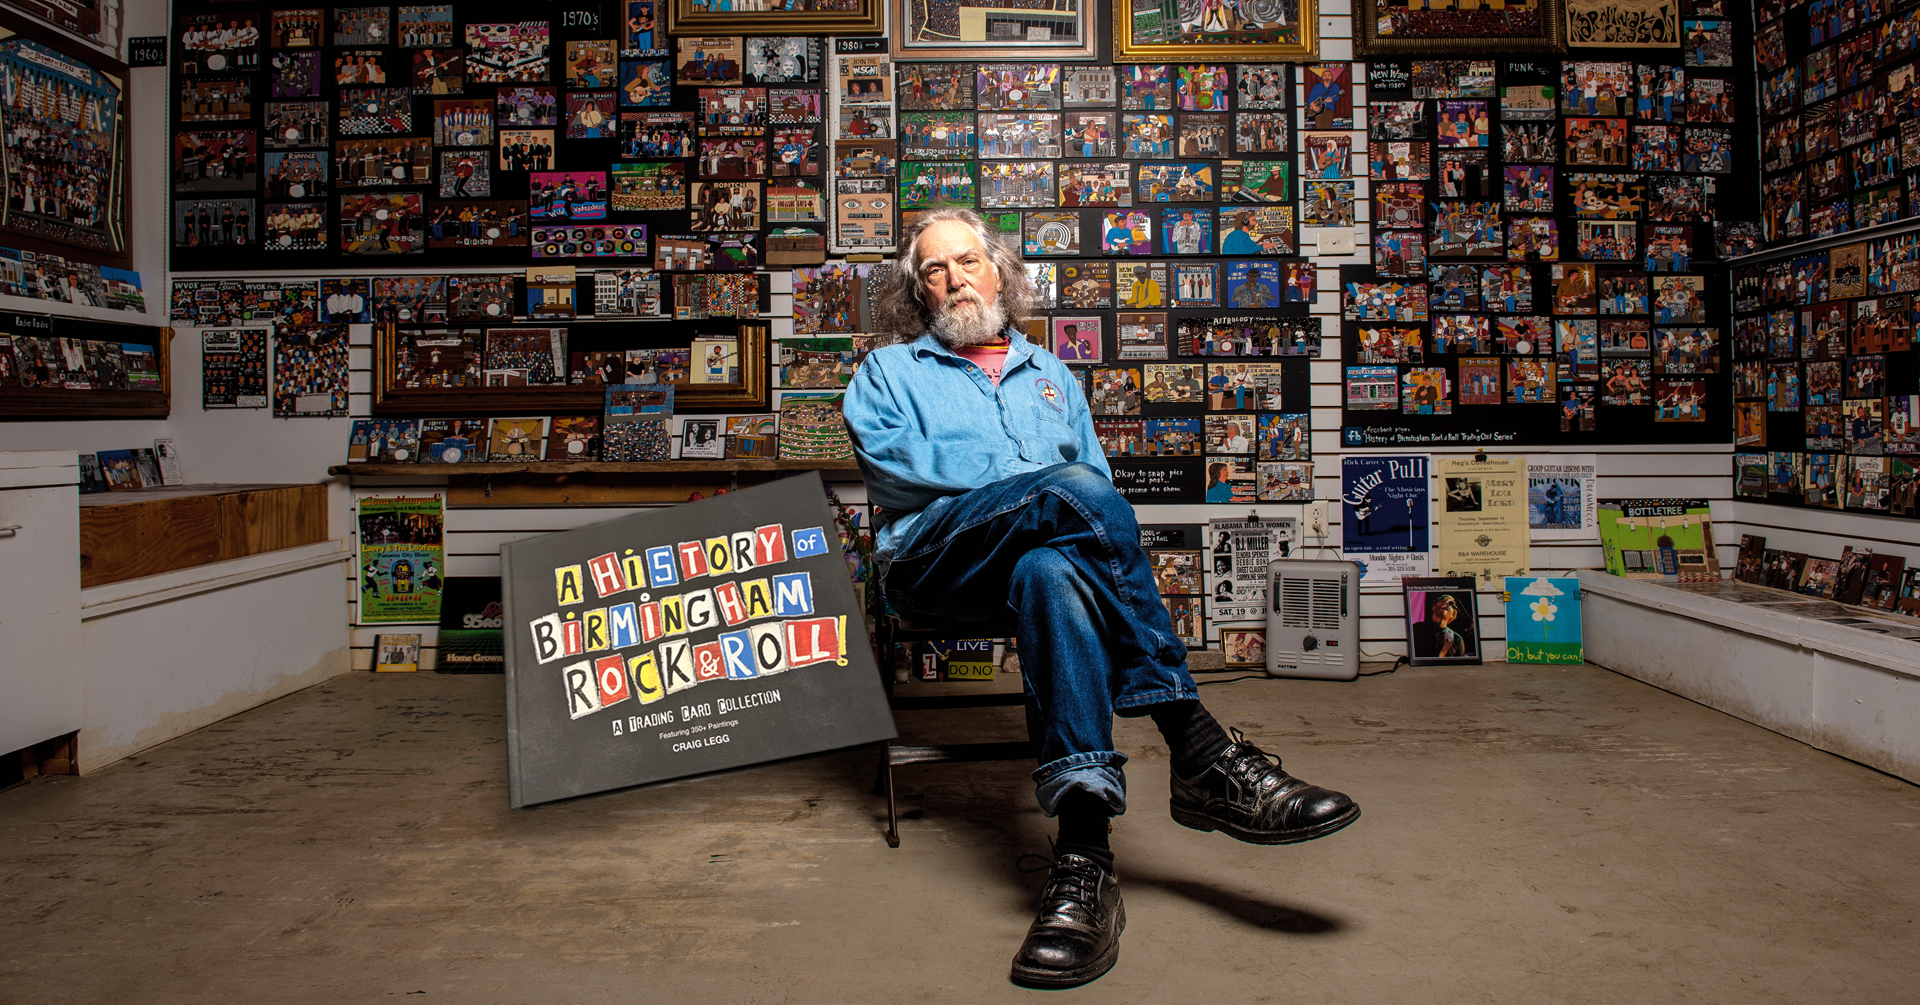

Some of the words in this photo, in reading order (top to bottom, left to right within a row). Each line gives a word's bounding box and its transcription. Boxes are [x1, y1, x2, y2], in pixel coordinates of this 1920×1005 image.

[563, 11, 598, 26] 1970's
[838, 40, 863, 50] 1980's
[1509, 62, 1534, 72] PUNK
[1370, 70, 1388, 82] New
[1000, 214, 1019, 230] 99
[16, 316, 31, 328] Radio
[32, 318, 49, 328] Radio
[1214, 316, 1253, 325] ASTROLOGY
[1348, 430, 1361, 442] fb
[1114, 469, 1135, 480] Okay
[1148, 470, 1165, 480] snap
[1169, 469, 1183, 478] pics
[1342, 470, 1383, 506] Guitar
[1388, 458, 1424, 480] Pull
[1628, 506, 1683, 516] BOTTLETREE
[362, 544, 385, 553] Larry
[409, 543, 440, 551] Loafers
[1247, 537, 1268, 550] MILLER
[1369, 554, 1386, 563] Monday
[556, 566, 582, 605] A
[589, 525, 786, 597] HISTORY
[794, 530, 822, 555] of
[462, 613, 502, 629] 95RO
[529, 572, 814, 664] BIRMINGHAM
[956, 642, 989, 651] LIVE
[446, 654, 471, 662] Home
[473, 654, 502, 662] Grown
[1507, 647, 1527, 662] Oh,
[1527, 647, 1544, 661] but
[1545, 652, 1561, 663] you
[1562, 649, 1582, 662] can!
[949, 665, 964, 675] DO
[612, 720, 623, 736] A
[628, 710, 674, 732] TRADING
[681, 703, 712, 722] CARD
[717, 689, 782, 714] COLLECTION
[659, 728, 690, 739] Featuring
[690, 724, 707, 734] 350+
[708, 718, 739, 730] Paintings
[672, 740, 702, 752] CRAIG
[704, 734, 730, 747] LEGG
